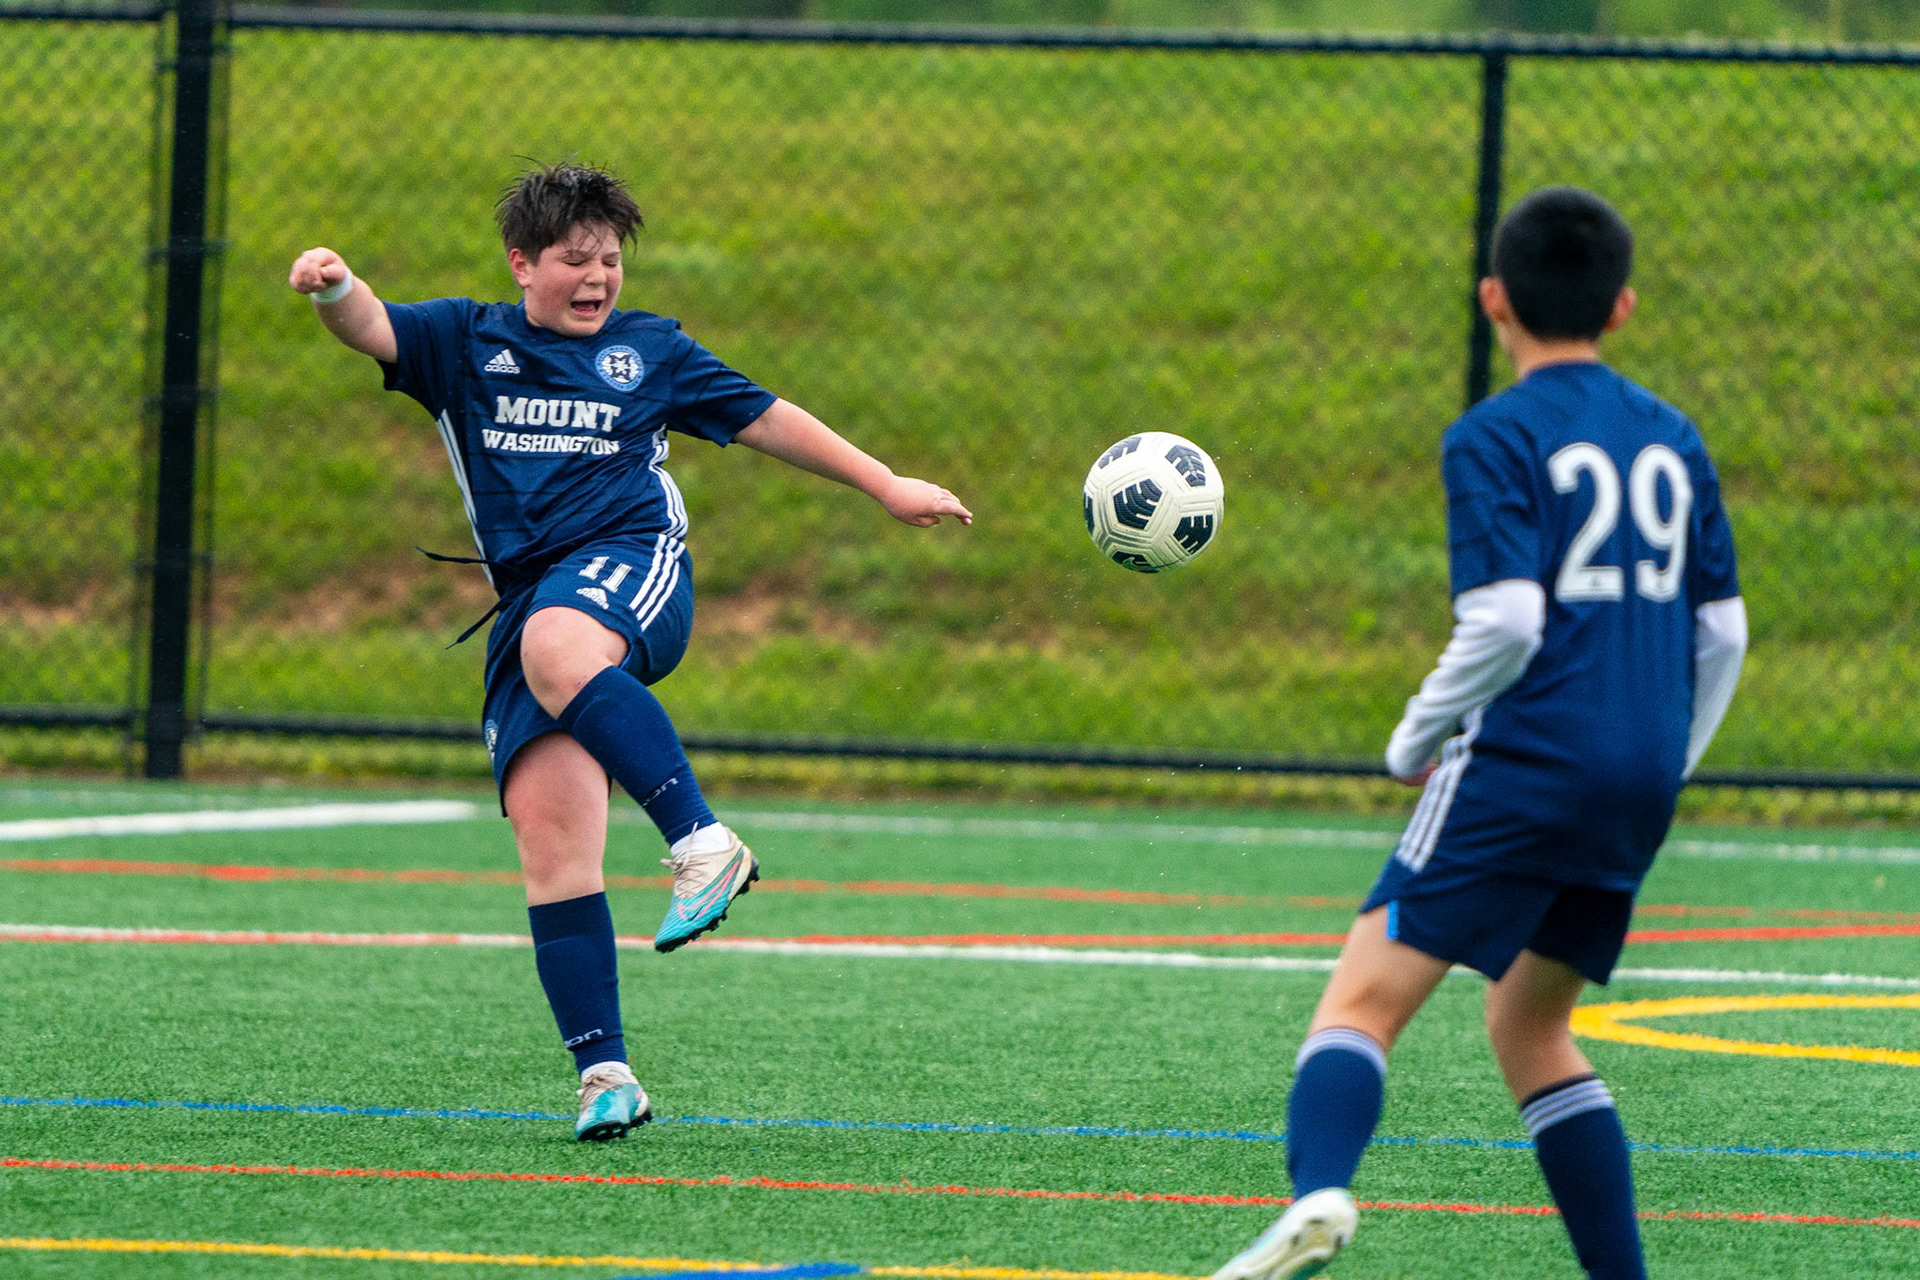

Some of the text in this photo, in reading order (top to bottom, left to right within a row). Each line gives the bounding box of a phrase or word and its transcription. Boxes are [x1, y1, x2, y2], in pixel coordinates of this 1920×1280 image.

[484, 364, 521, 374] adidas
[495, 395, 621, 432] MOUNT
[482, 428, 620, 455] WASHINGTON
[1547, 441, 1694, 603] 29
[578, 556, 633, 593] 11
